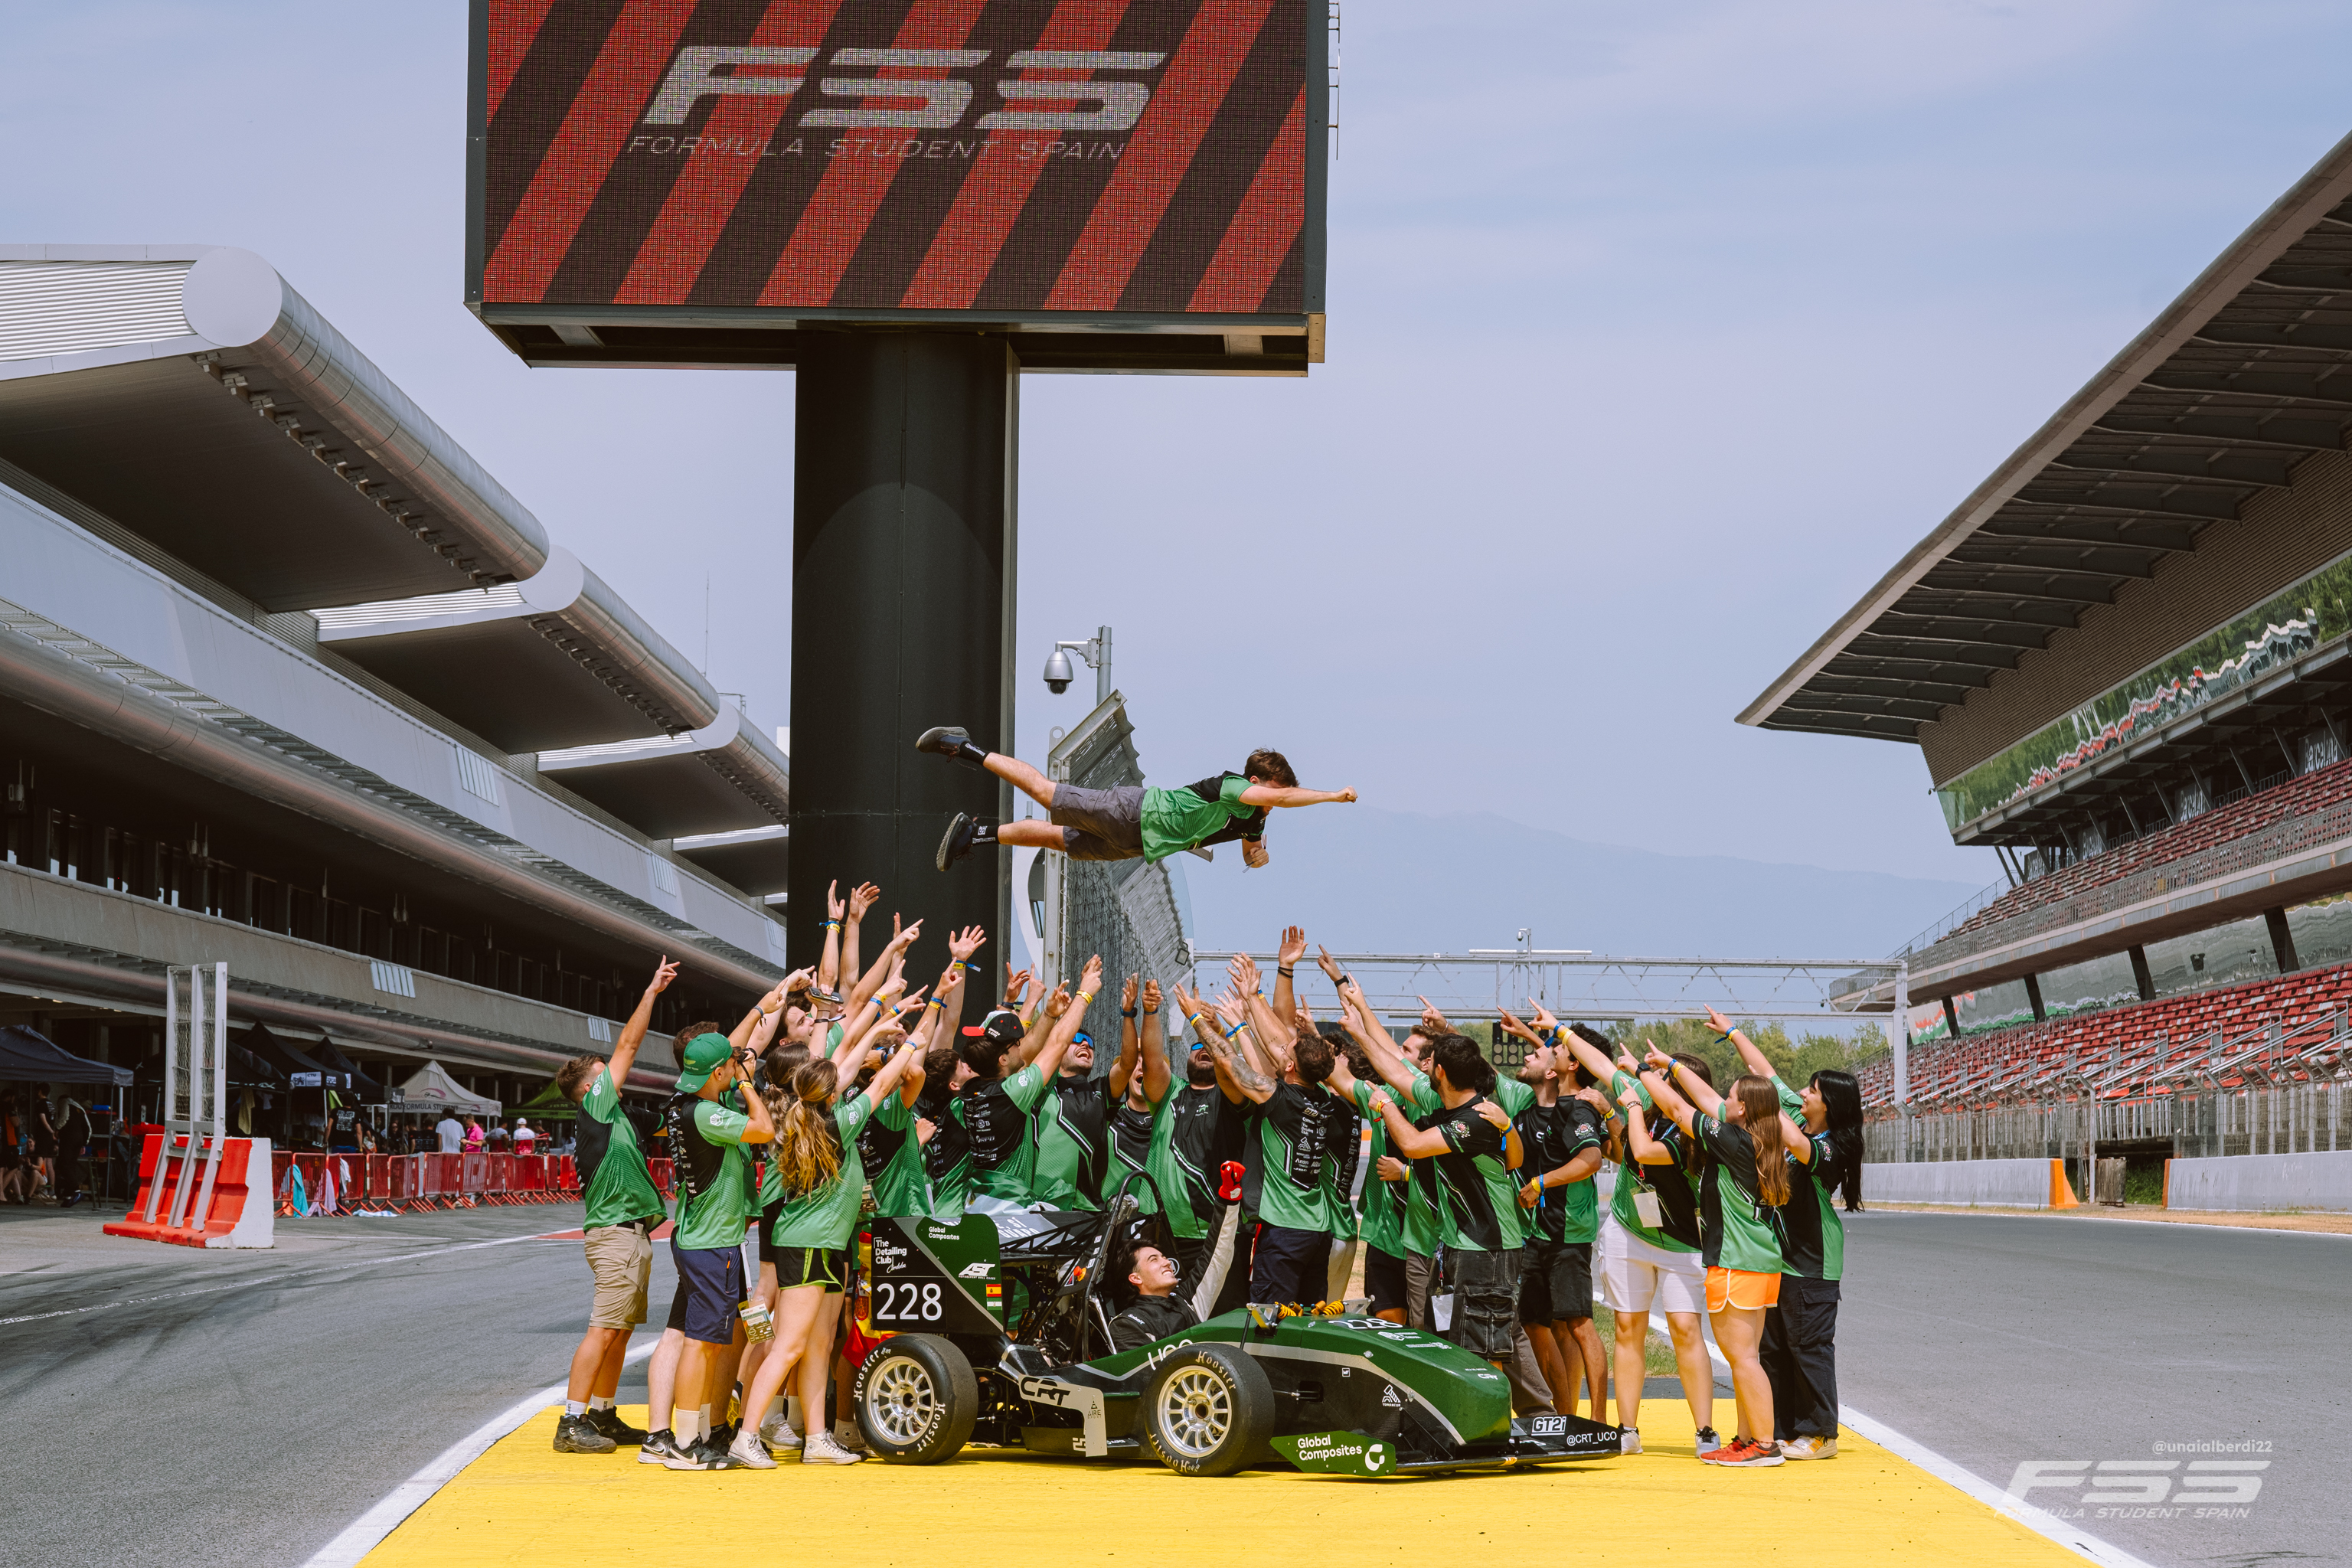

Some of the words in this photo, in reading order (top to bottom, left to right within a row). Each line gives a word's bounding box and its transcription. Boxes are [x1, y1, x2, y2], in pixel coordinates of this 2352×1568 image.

[642, 46, 1168, 131] FSS
[627, 136, 804, 155] FORMULA
[825, 137, 1000, 159] STUDENT
[1016, 140, 1126, 161] SPAIN
[875, 1247, 907, 1256] Detailing
[876, 1239, 889, 1248] The
[875, 1256, 892, 1265] Club
[958, 1263, 996, 1276] AST
[877, 1282, 942, 1321] 228
[1328, 1318, 1403, 1330] 228
[853, 1349, 880, 1403] Hoosier
[1194, 1350, 1237, 1390] Hoosier
[1020, 1376, 1071, 1406] CRT
[916, 1399, 946, 1452] Hoosier
[1533, 1416, 1566, 1432] GT2i
[1297, 1434, 1331, 1449] Global
[1566, 1431, 1617, 1446] @CRT_UCO
[1298, 1444, 1363, 1462] Composites
